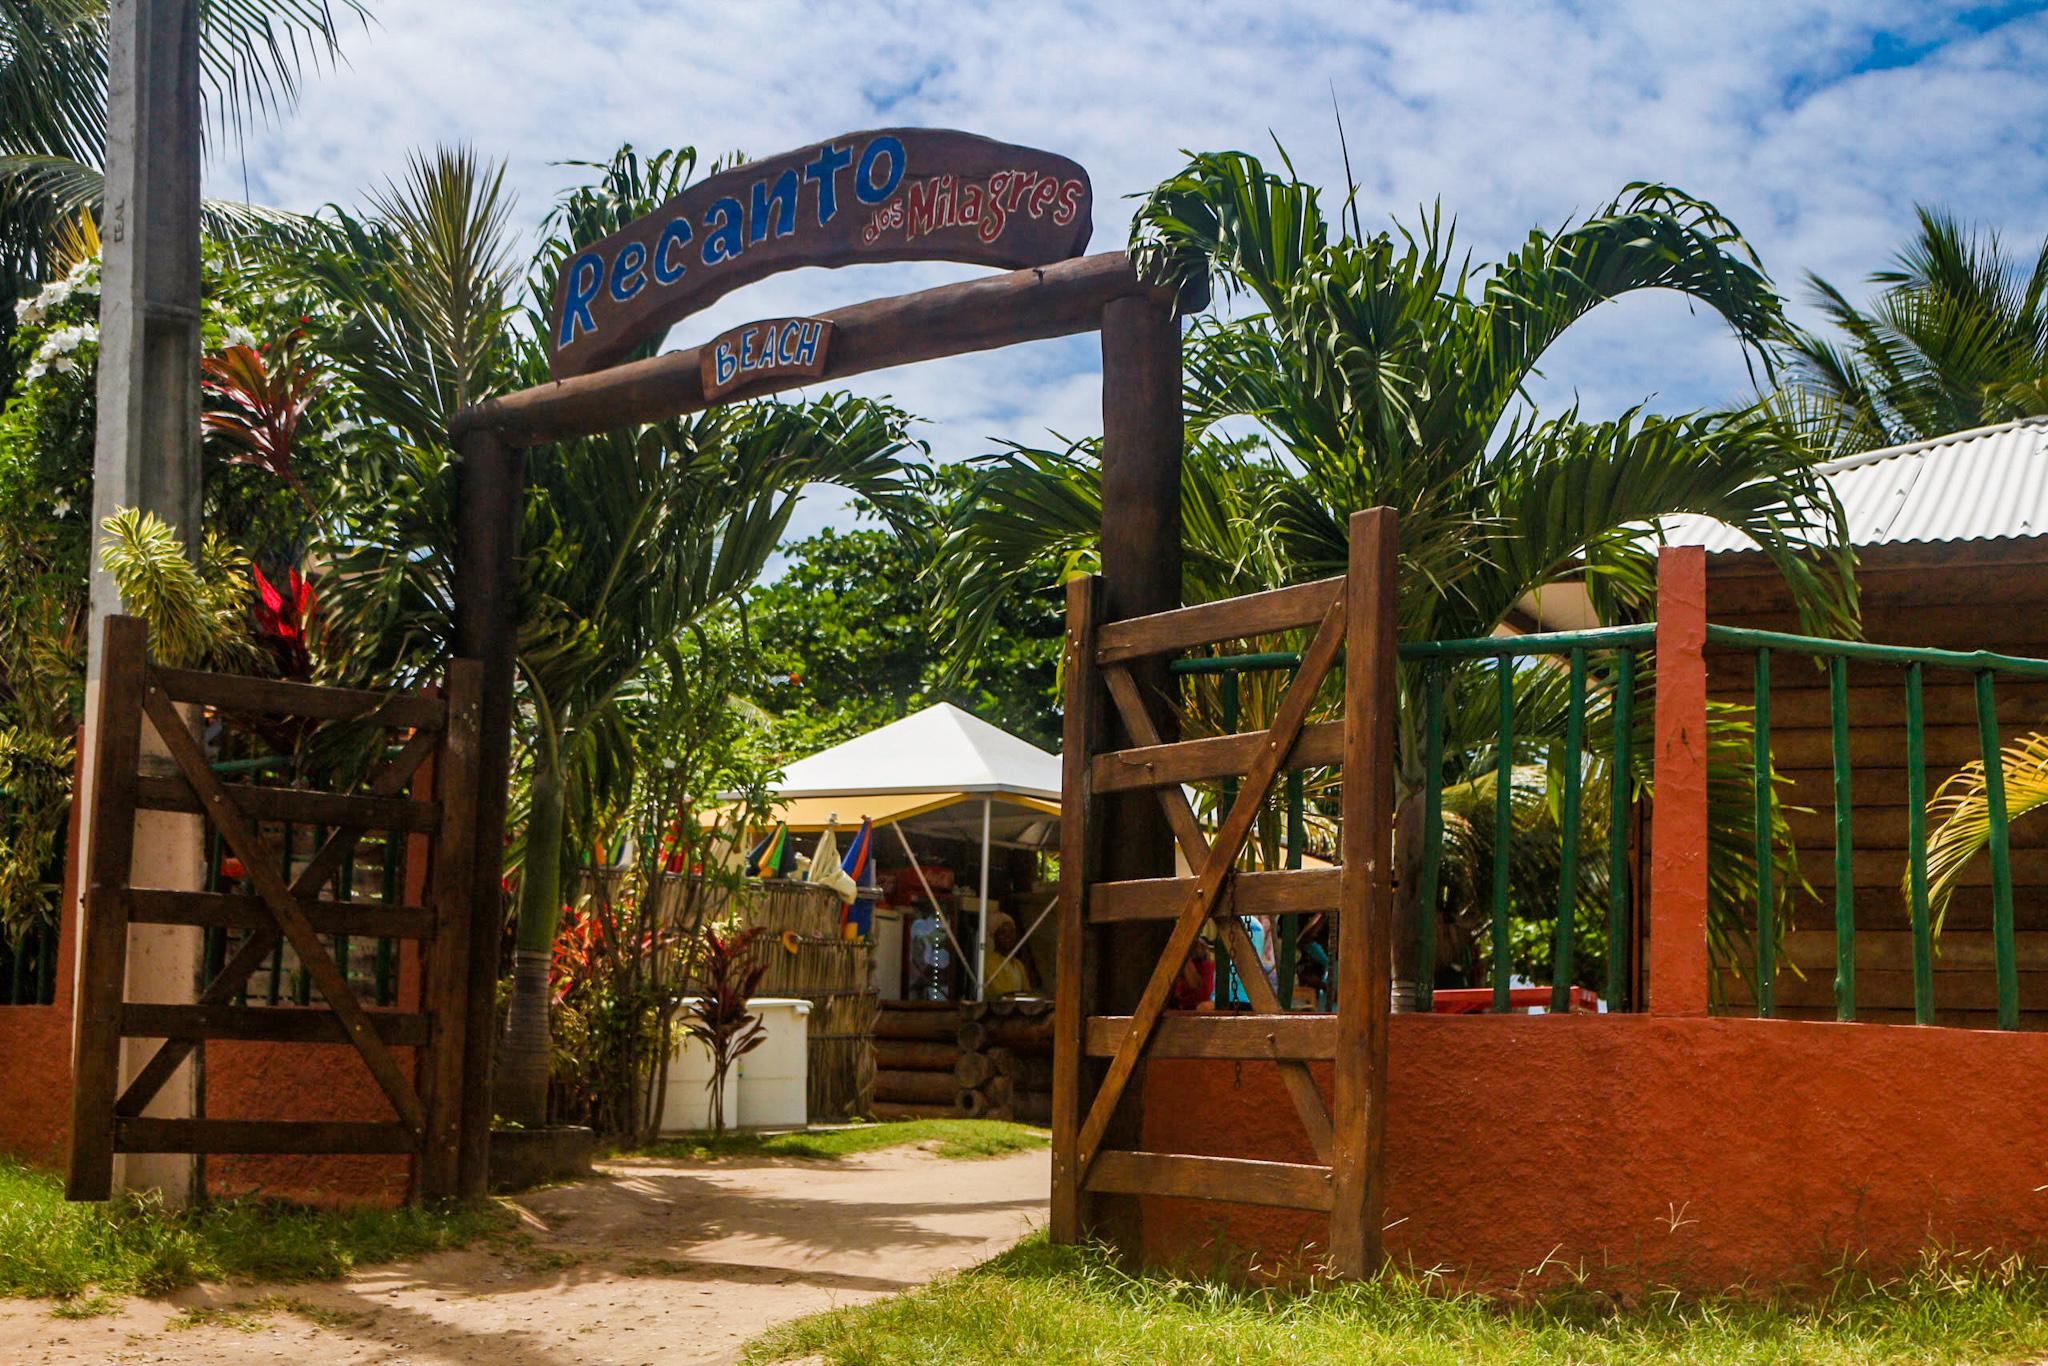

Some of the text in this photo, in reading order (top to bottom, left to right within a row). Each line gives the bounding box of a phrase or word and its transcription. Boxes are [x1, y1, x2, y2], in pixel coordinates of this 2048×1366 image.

[558, 135, 907, 350] Recanto
[863, 169, 1084, 245] dos Milagres
[715, 320, 822, 386] BEACH
